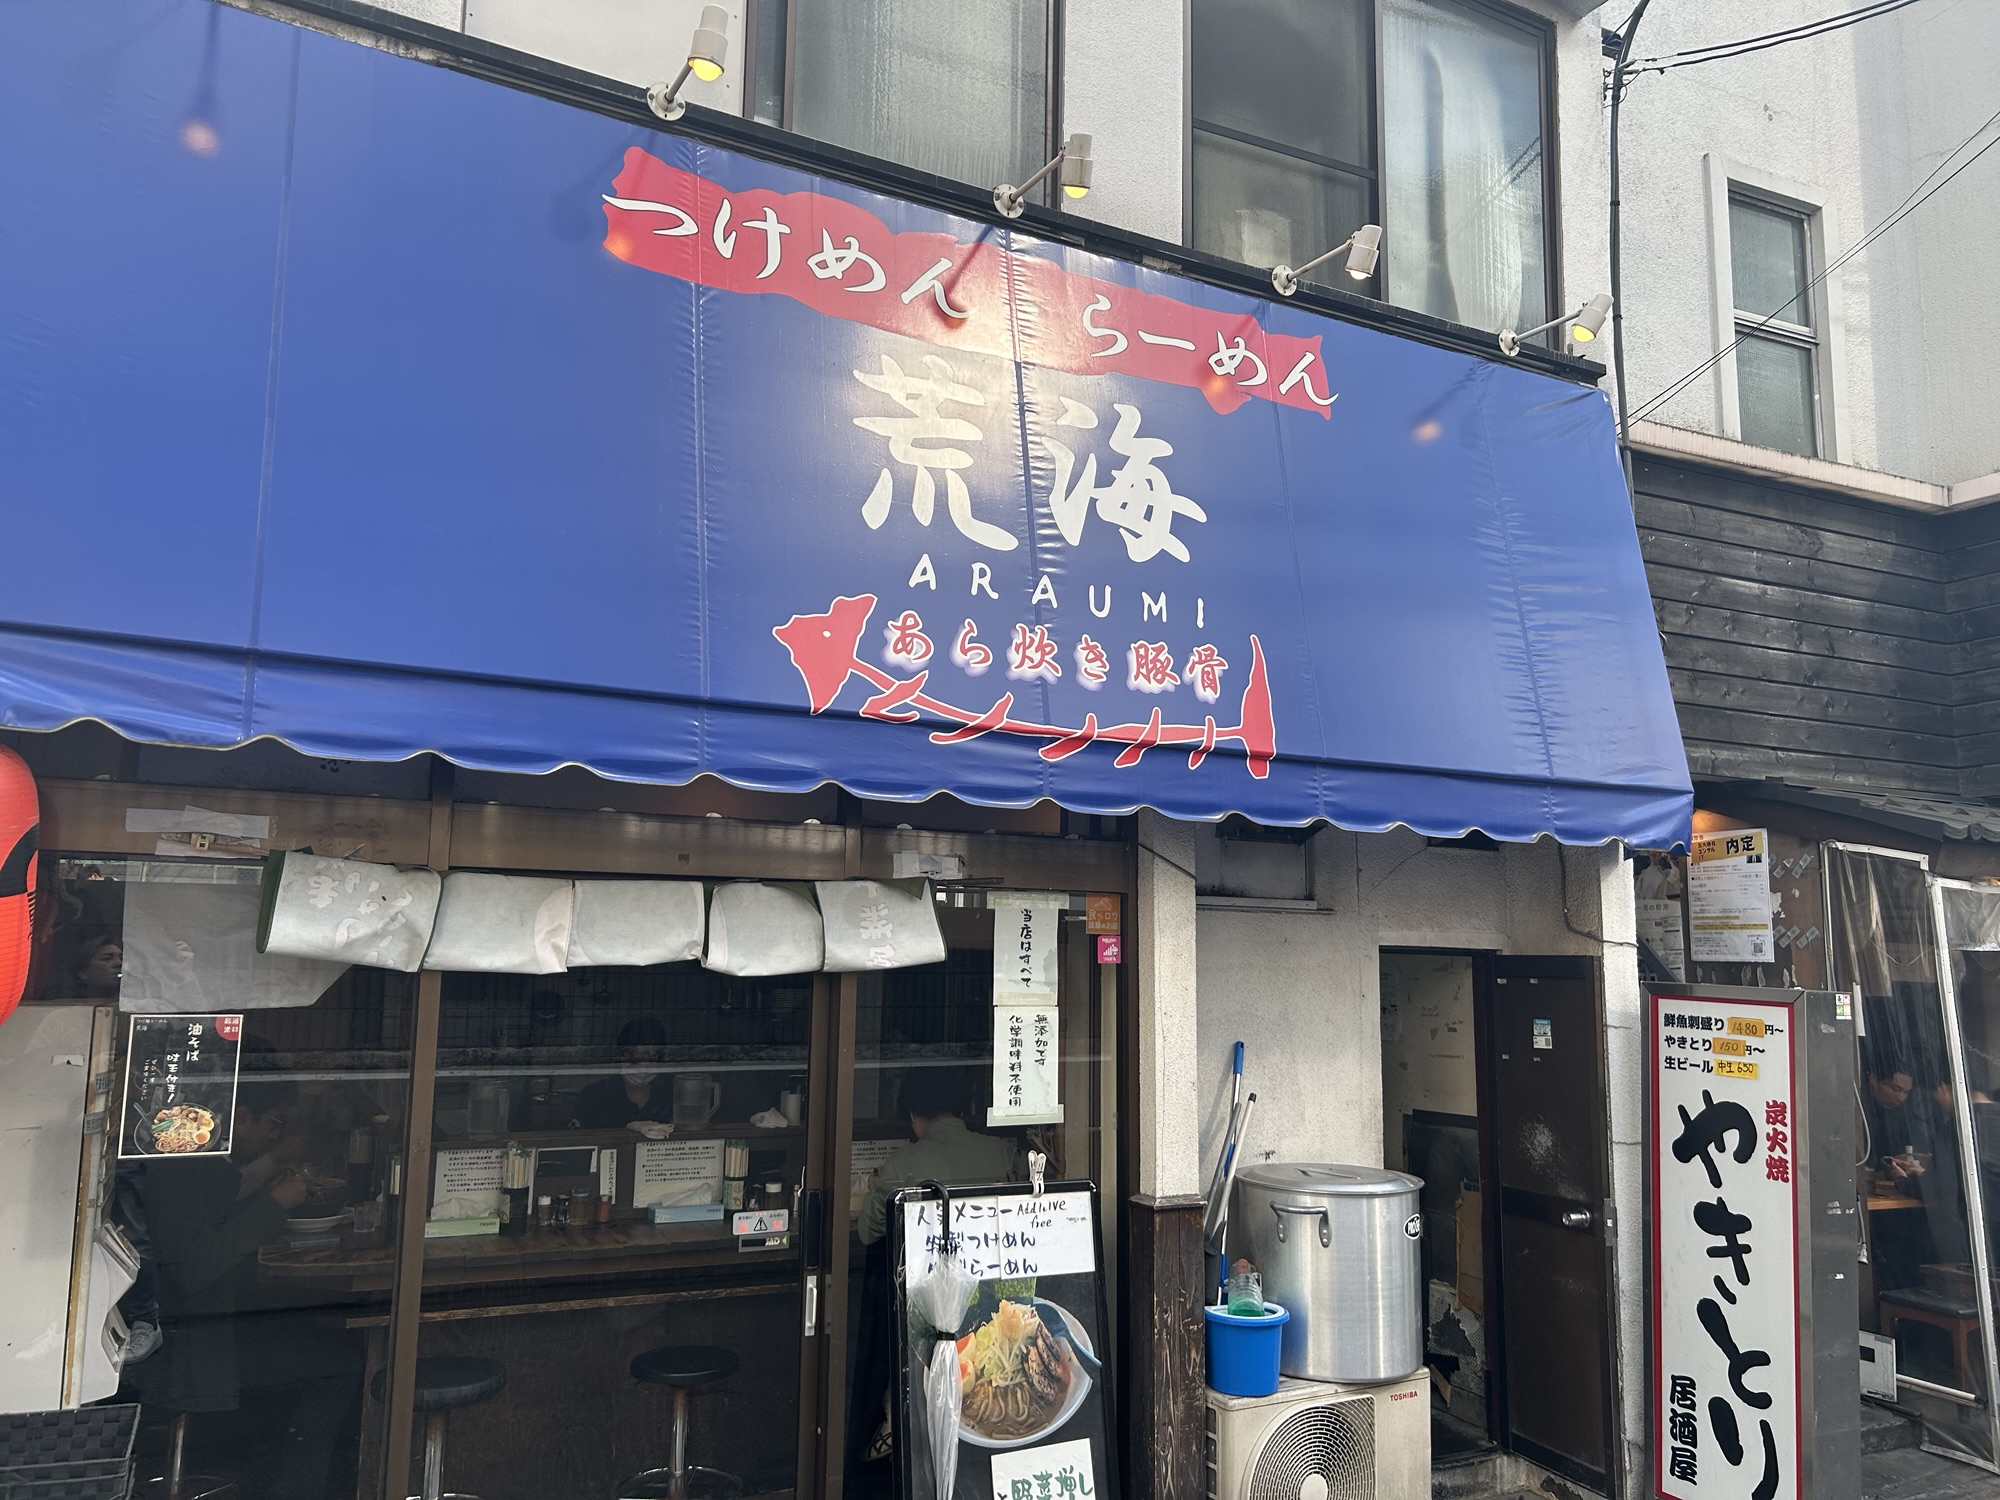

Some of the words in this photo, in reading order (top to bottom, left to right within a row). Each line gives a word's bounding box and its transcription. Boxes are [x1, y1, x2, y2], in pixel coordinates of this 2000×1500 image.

[602, 193, 970, 319] つけめん
[1084, 294, 1338, 406] らーめん
[853, 355, 1207, 562] 荒海
[909, 553, 1205, 628] ARAUMI
[887, 609, 1229, 699] あら炊き豚骨
[1725, 835, 1756, 855] 内定
[1088, 908, 1118, 921] 食べログ
[1018, 908, 1034, 988] 当店はすべて
[186, 1022, 203, 1062] 油そば
[1034, 1014, 1050, 1066] 無添加です
[1663, 1012, 1725, 1031] 鮮魚刺盛り
[1732, 1022, 1758, 1035] 1480
[1663, 1034, 1712, 1052] やきとり
[1719, 1042, 1739, 1052] 150
[1008, 1014, 1024, 1108] 化学調味料不使用
[1664, 1055, 1714, 1074] 生ビール
[1737, 1062, 1754, 1074] 650
[1764, 1099, 1790, 1184] 炭火焼
[1030, 1216, 1053, 1229] free
[1672, 1088, 1779, 1500] やきとり
[1390, 1390, 1418, 1402] TOSHIBA
[1669, 1373, 1698, 1486] 居酒屋
